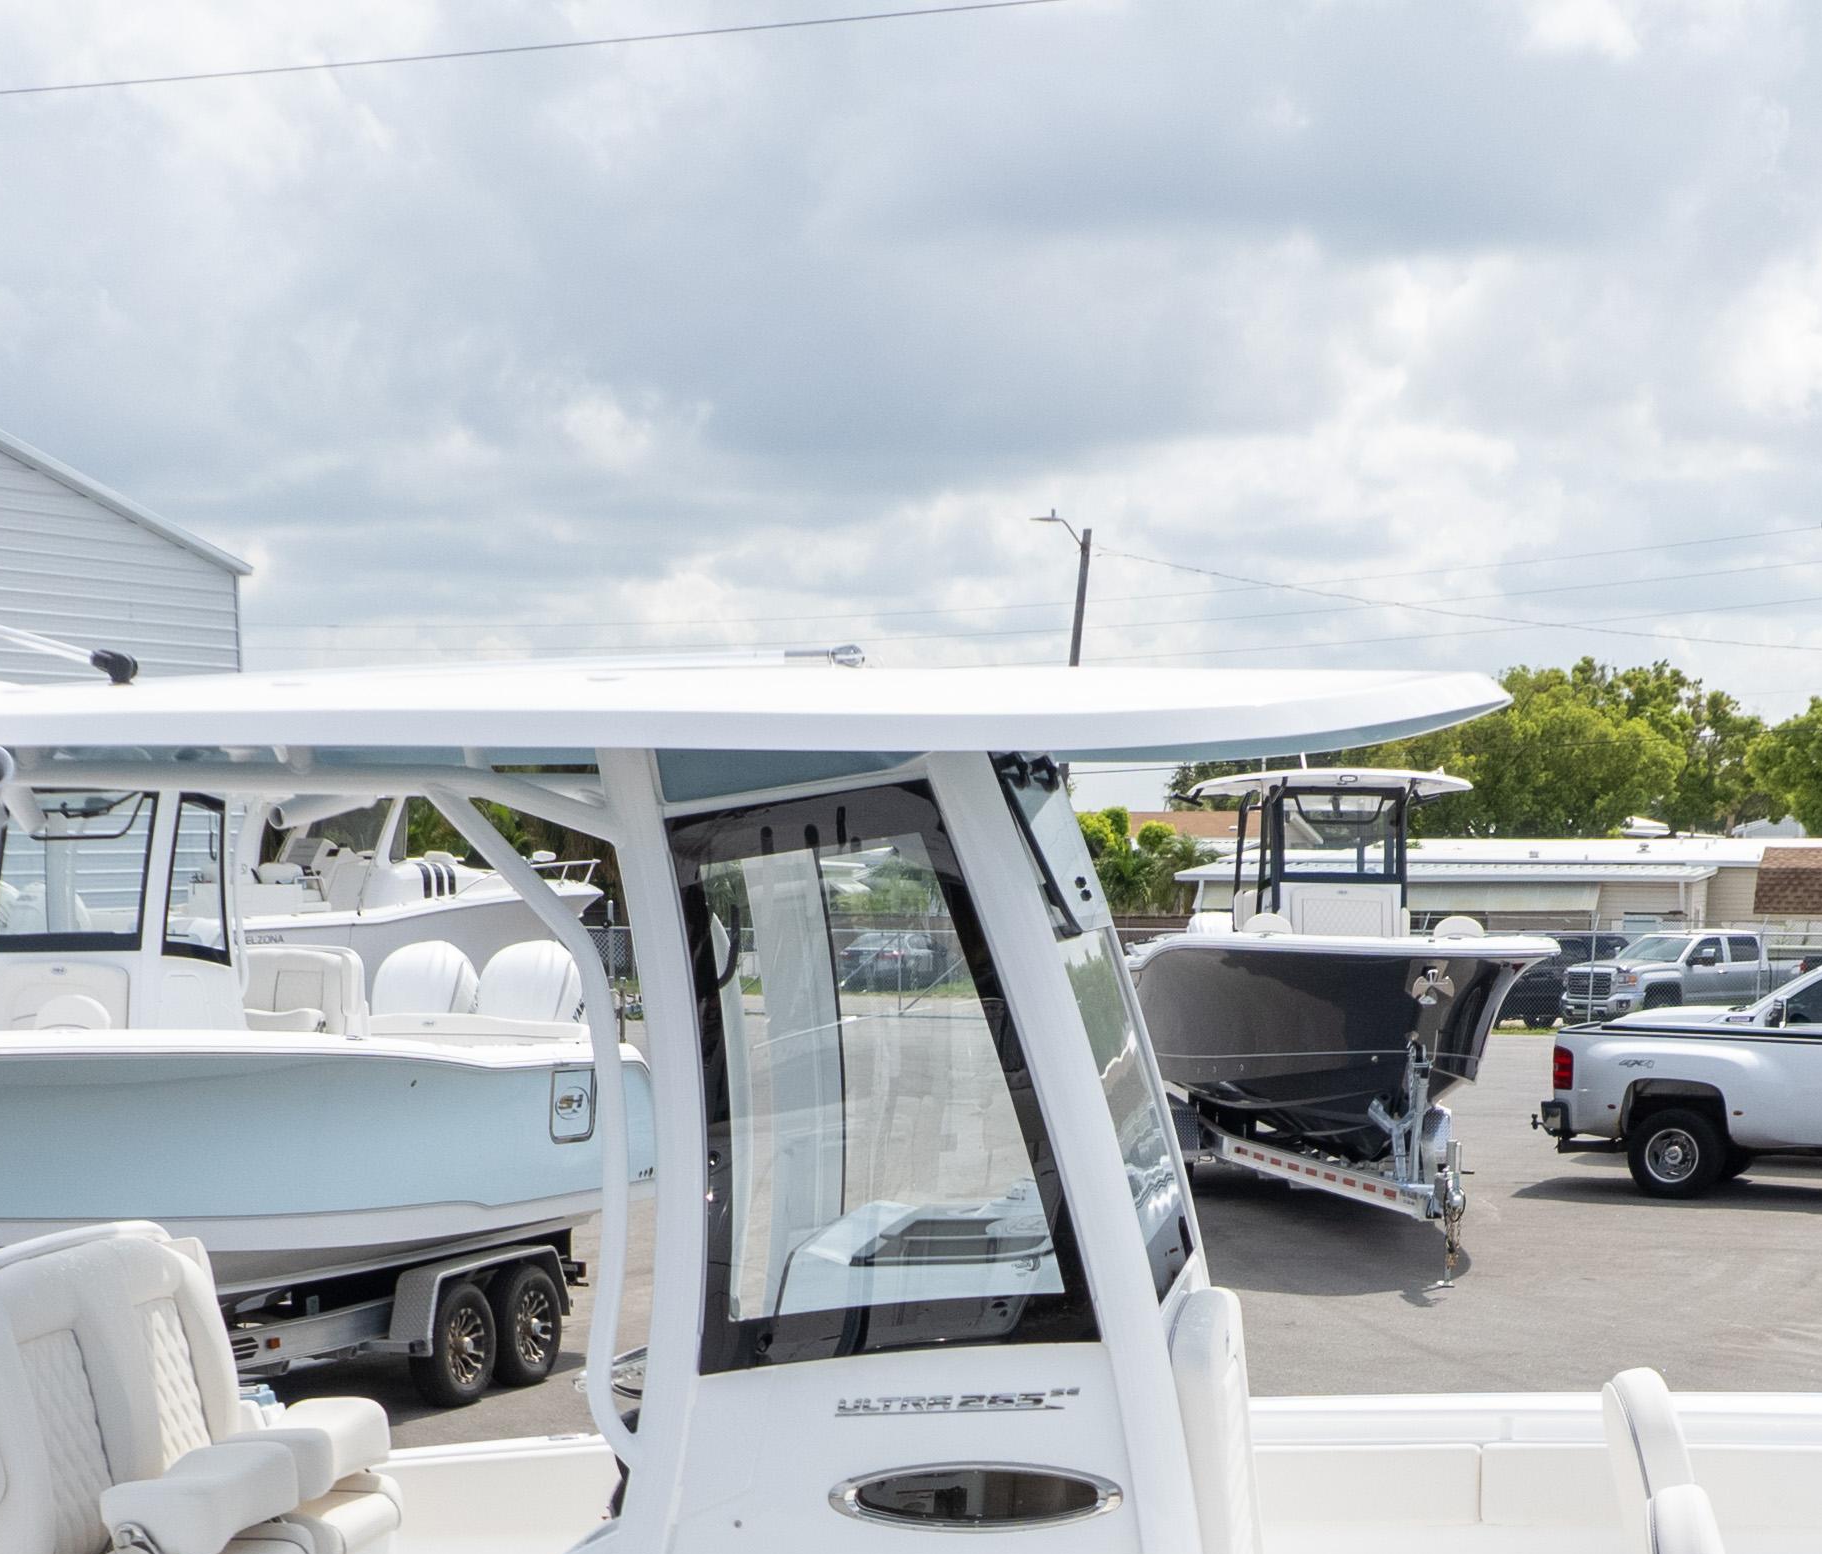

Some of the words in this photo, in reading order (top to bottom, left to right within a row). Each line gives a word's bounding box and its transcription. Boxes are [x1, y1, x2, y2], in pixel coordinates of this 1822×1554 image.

[233, 934, 285, 945] ELZONA
[837, 1396, 954, 1413] ULTRA
[957, 1392, 1046, 1410] 265
